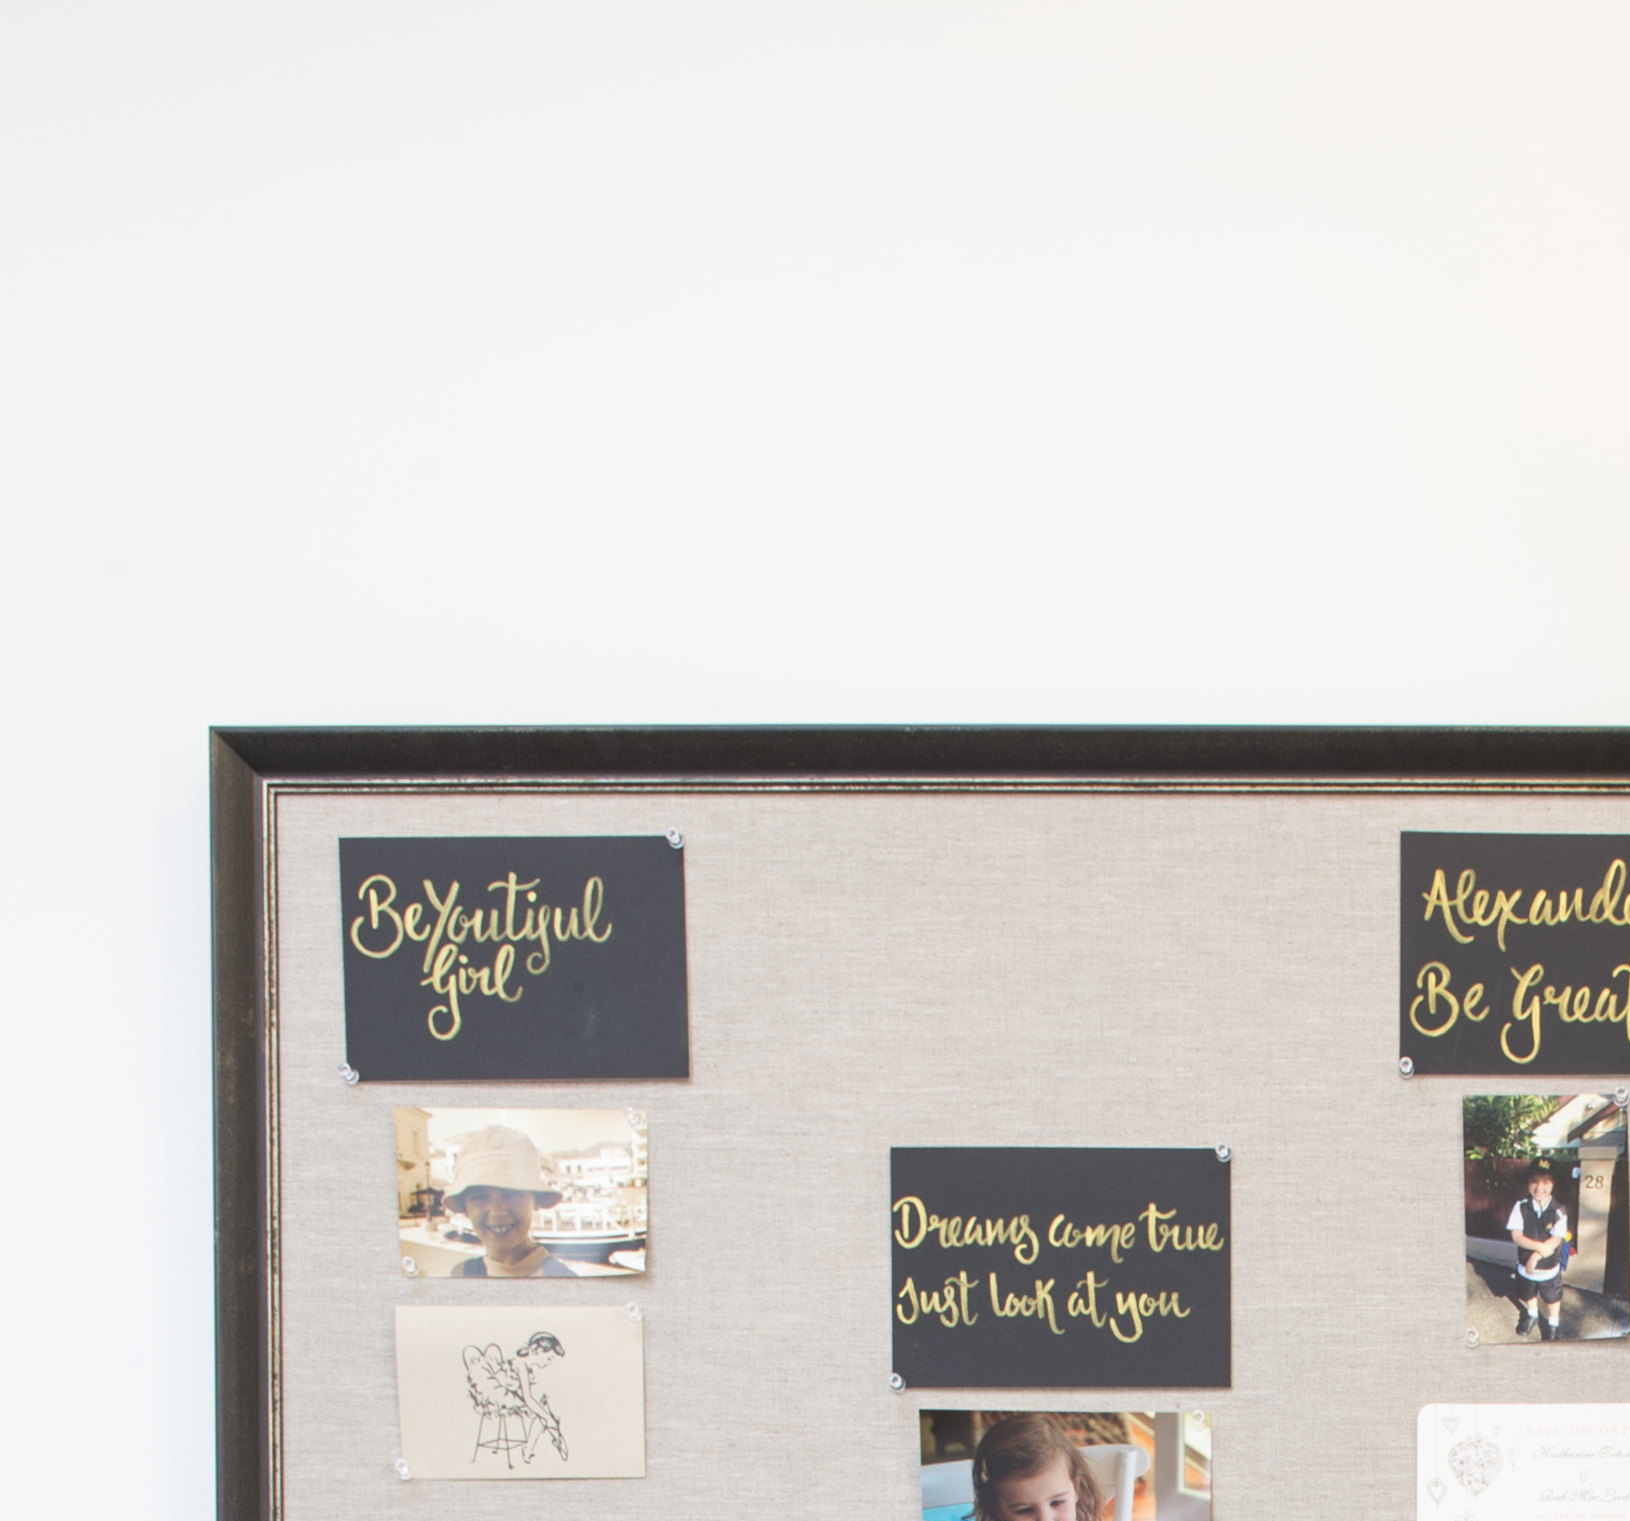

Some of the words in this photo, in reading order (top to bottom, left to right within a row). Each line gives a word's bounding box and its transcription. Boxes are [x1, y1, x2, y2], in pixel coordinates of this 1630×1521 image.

[420, 944, 523, 1040] Girl
[1410, 961, 1490, 1037] Be
[1585, 1175, 1604, 1190] 28
[893, 1196, 1039, 1265] Dreams
[1048, 1214, 1136, 1263] come
[1139, 1203, 1225, 1252] true
[897, 1271, 979, 1327] Just
[989, 1272, 1065, 1335] look
[1067, 1271, 1109, 1328] at
[1109, 1291, 1190, 1343] you
[1526, 1425, 1562, 1436] SAVE
[1567, 1425, 1594, 1436] THE
